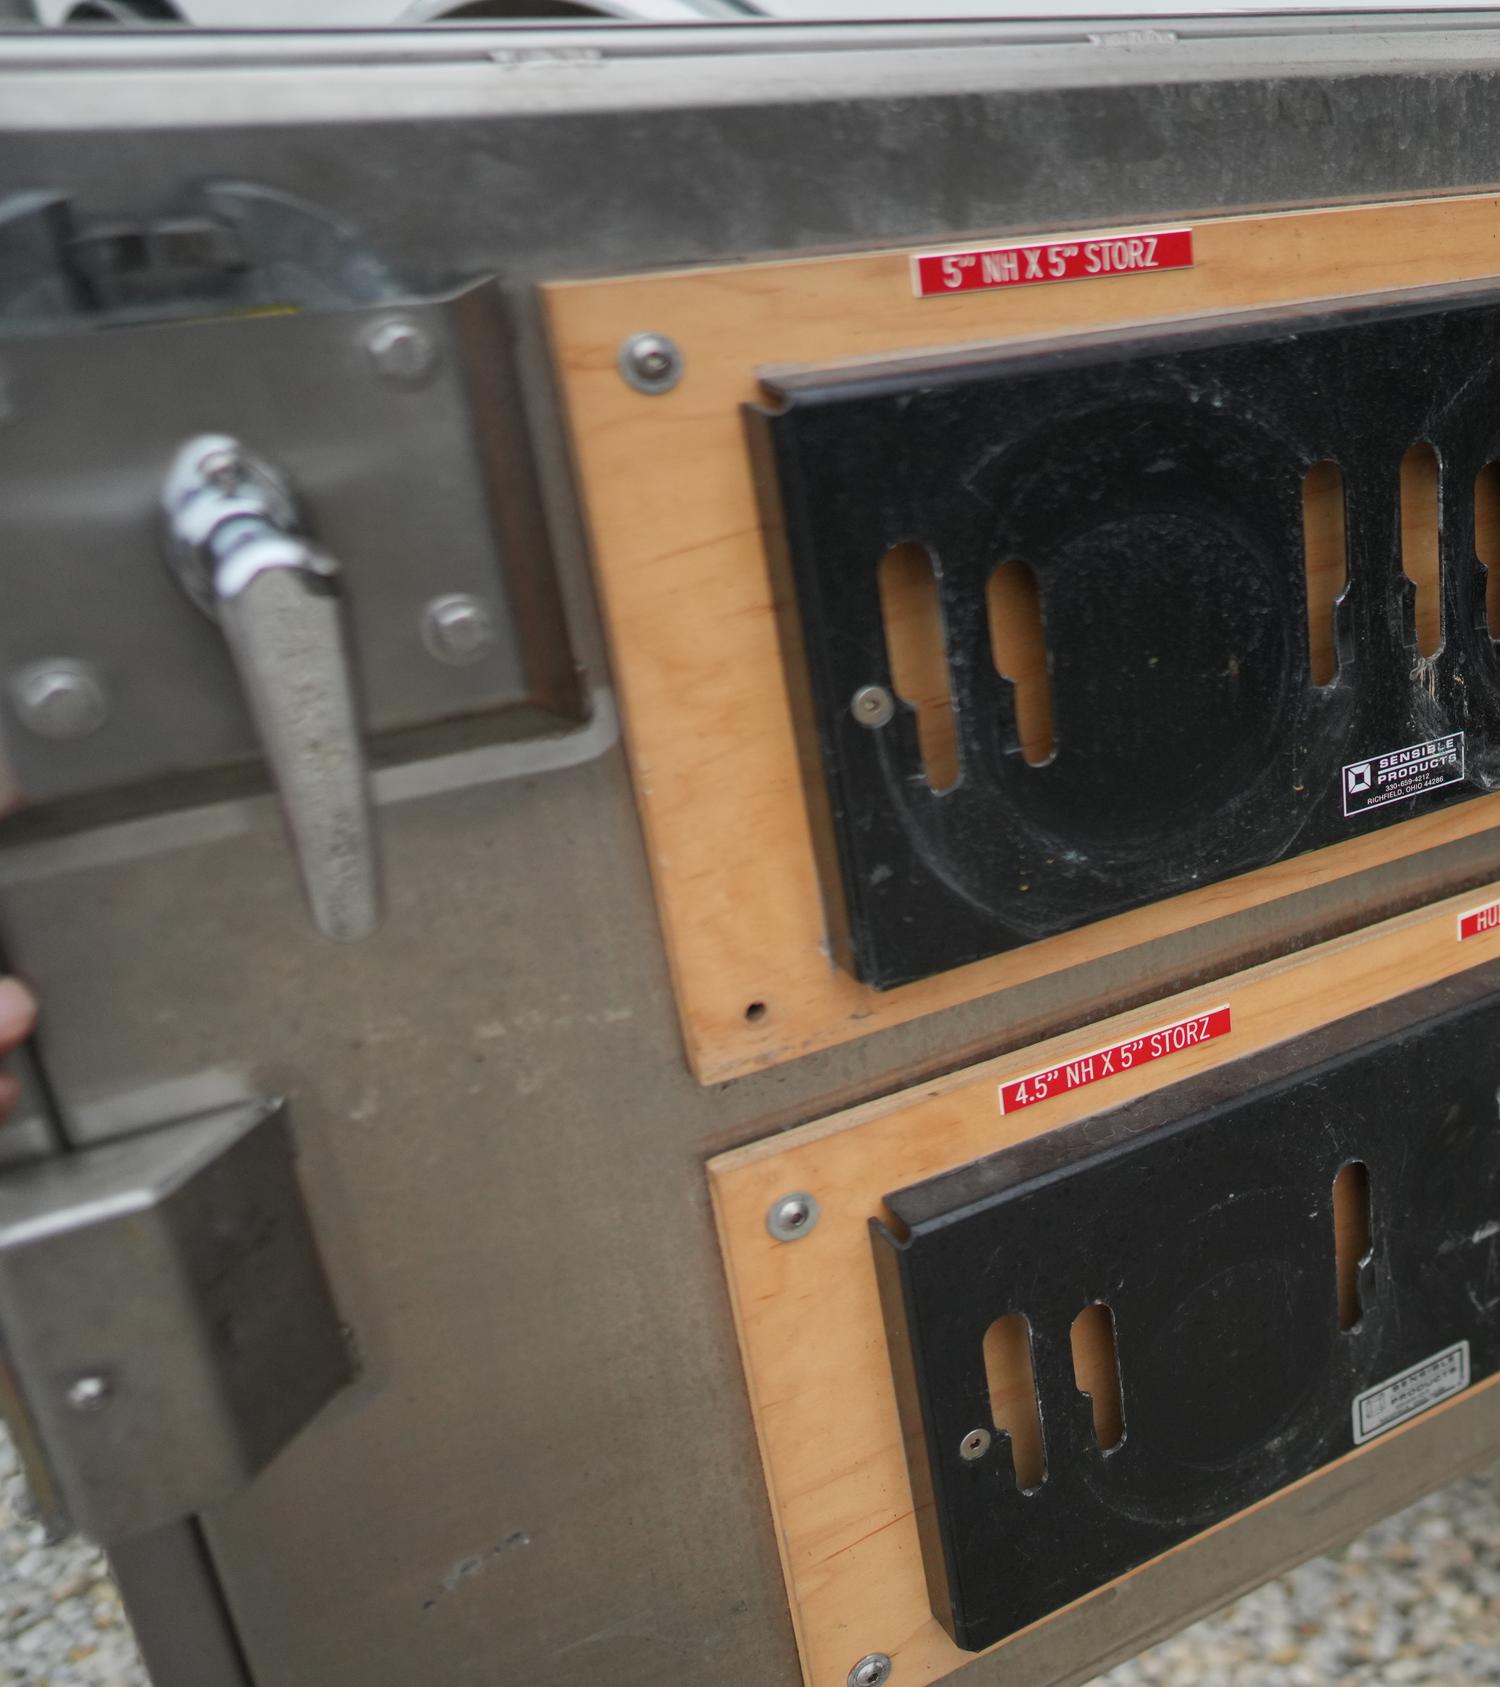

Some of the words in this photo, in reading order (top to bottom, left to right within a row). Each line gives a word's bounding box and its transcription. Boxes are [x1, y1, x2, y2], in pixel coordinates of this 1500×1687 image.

[981, 251, 1019, 284] NH
[1024, 249, 1044, 280] X
[1084, 238, 1159, 273] STORZ
[1377, 753, 1457, 785] PRODUCTS
[1379, 738, 1454, 769] SENSIBLE
[1405, 782, 1423, 793] OHIO
[1066, 1058, 1094, 1088] NH
[1101, 1050, 1115, 1076] X
[1151, 1016, 1210, 1057] STORZ
